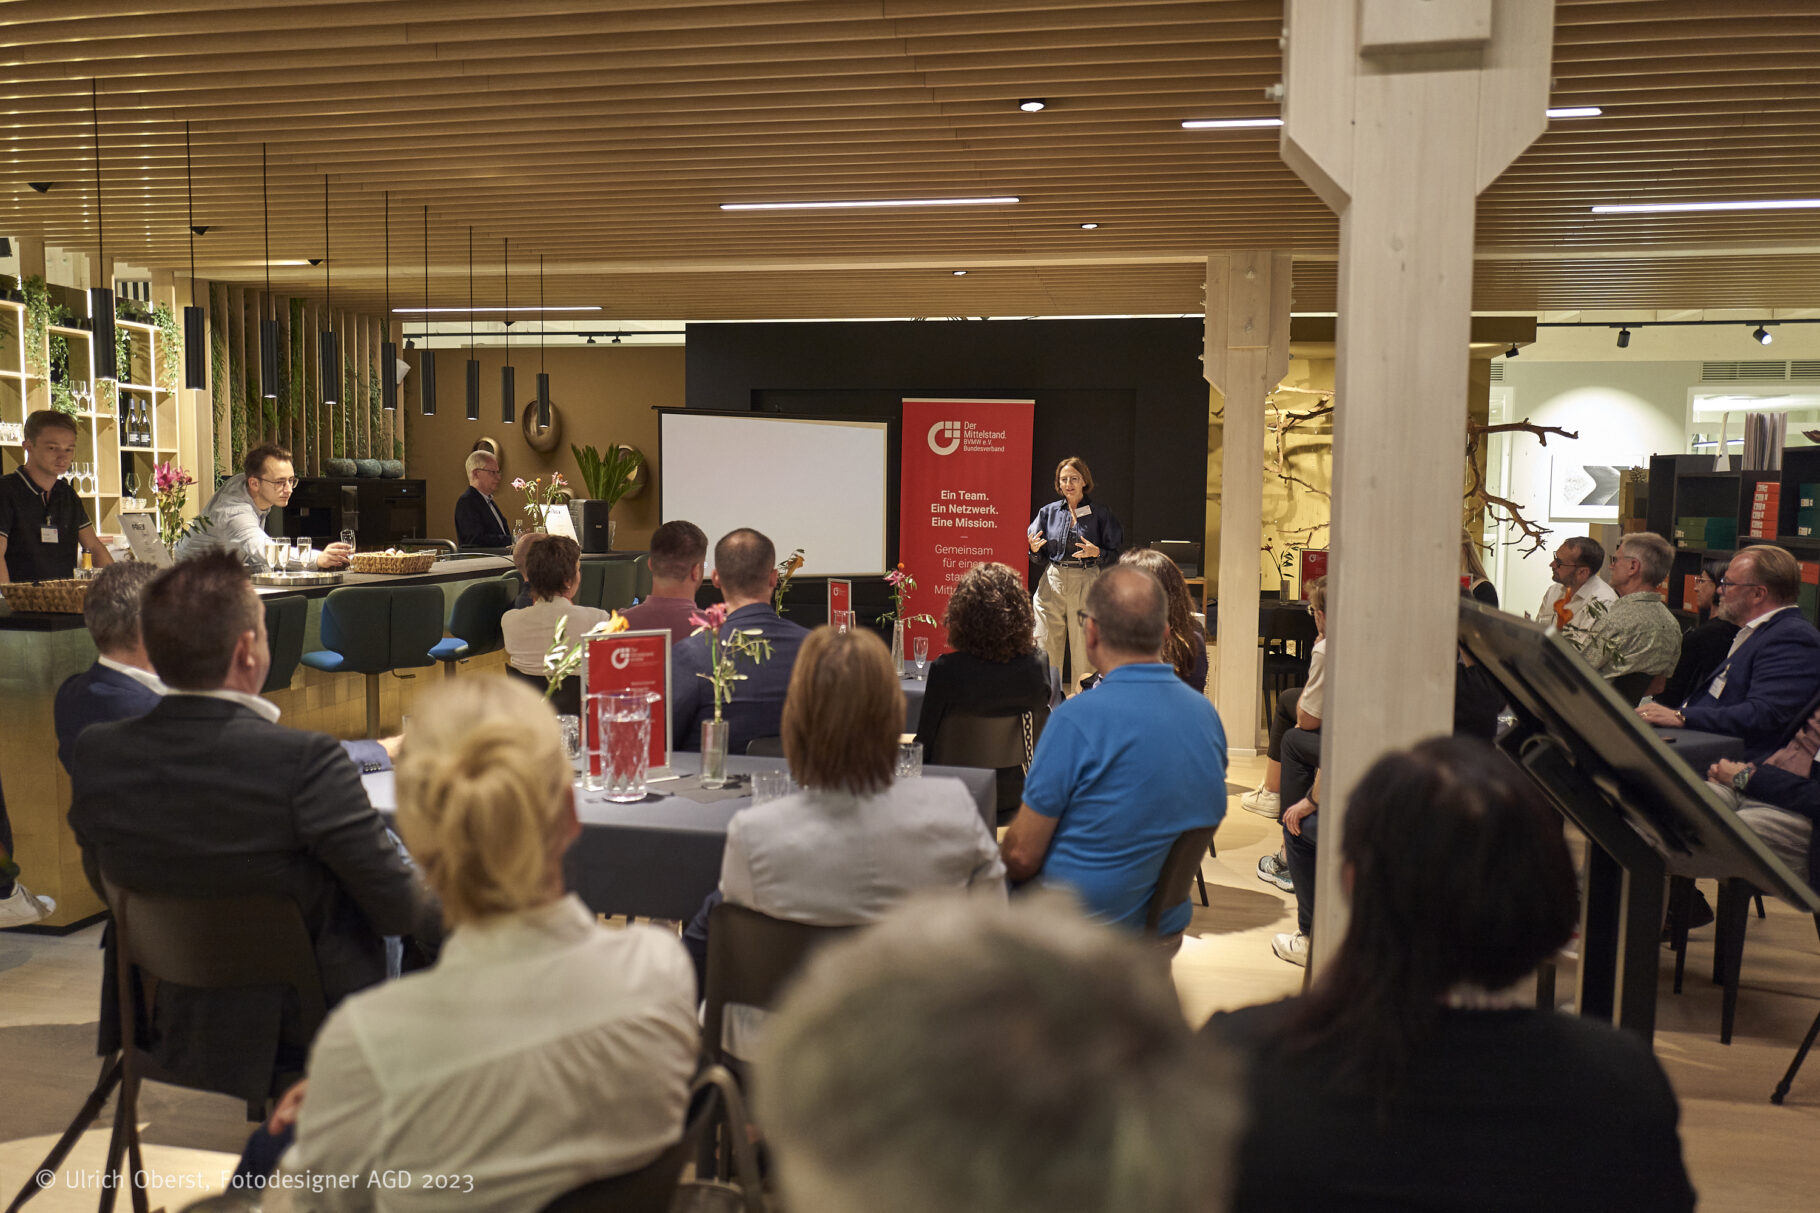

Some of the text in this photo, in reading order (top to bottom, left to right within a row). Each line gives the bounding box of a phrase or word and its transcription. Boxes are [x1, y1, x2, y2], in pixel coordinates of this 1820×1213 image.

[964, 421, 977, 430] Der
[941, 490, 989, 501] Ein Team.
[931, 503, 999, 515] Ein Netzwerk.
[931, 517, 998, 529] Eine Mission.
[935, 544, 993, 556] Gemeinsam
[943, 558, 984, 569] für eine
